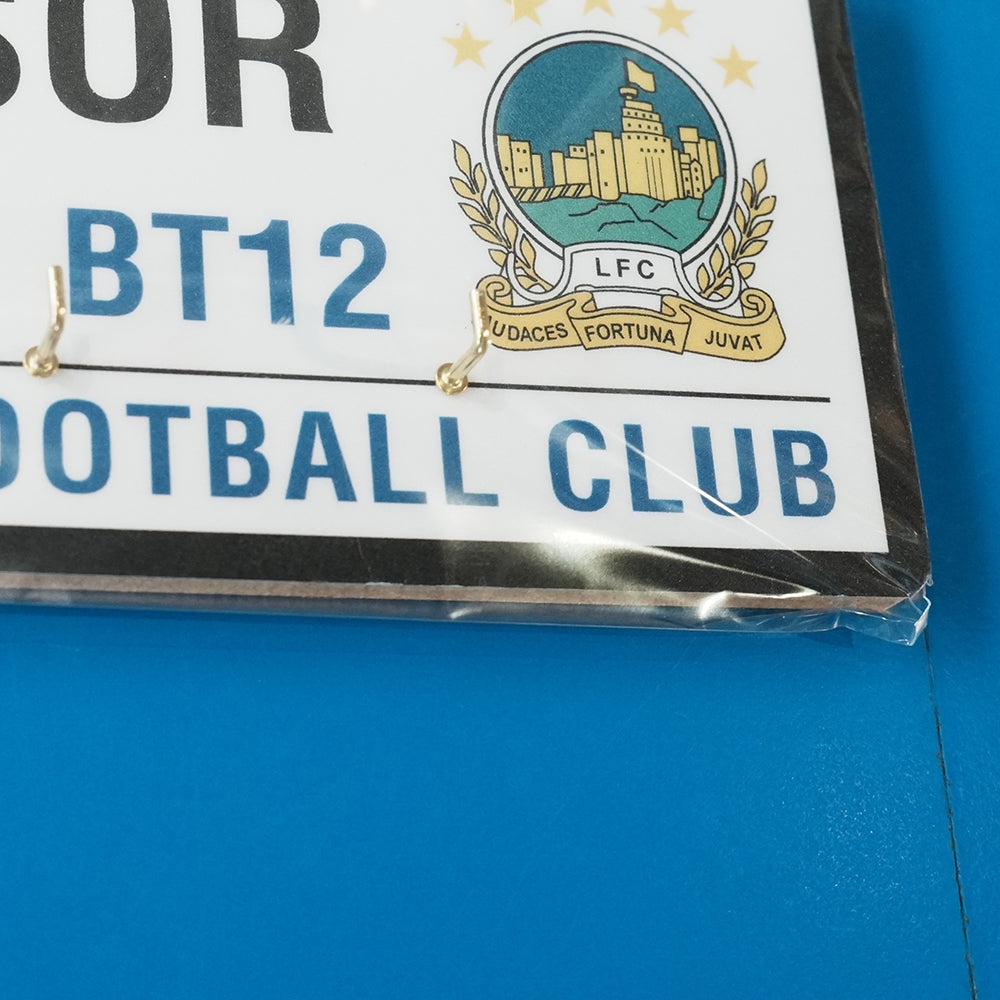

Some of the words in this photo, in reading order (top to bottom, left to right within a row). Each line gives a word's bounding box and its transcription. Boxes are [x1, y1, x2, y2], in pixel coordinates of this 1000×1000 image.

[67, 207, 391, 331] BT12
[595, 257, 655, 280] LFC
[486, 315, 569, 342] UDACES
[584, 322, 676, 346] FORTUNA
[704, 330, 763, 352] JUVAT
[547, 419, 838, 520] CLUB
